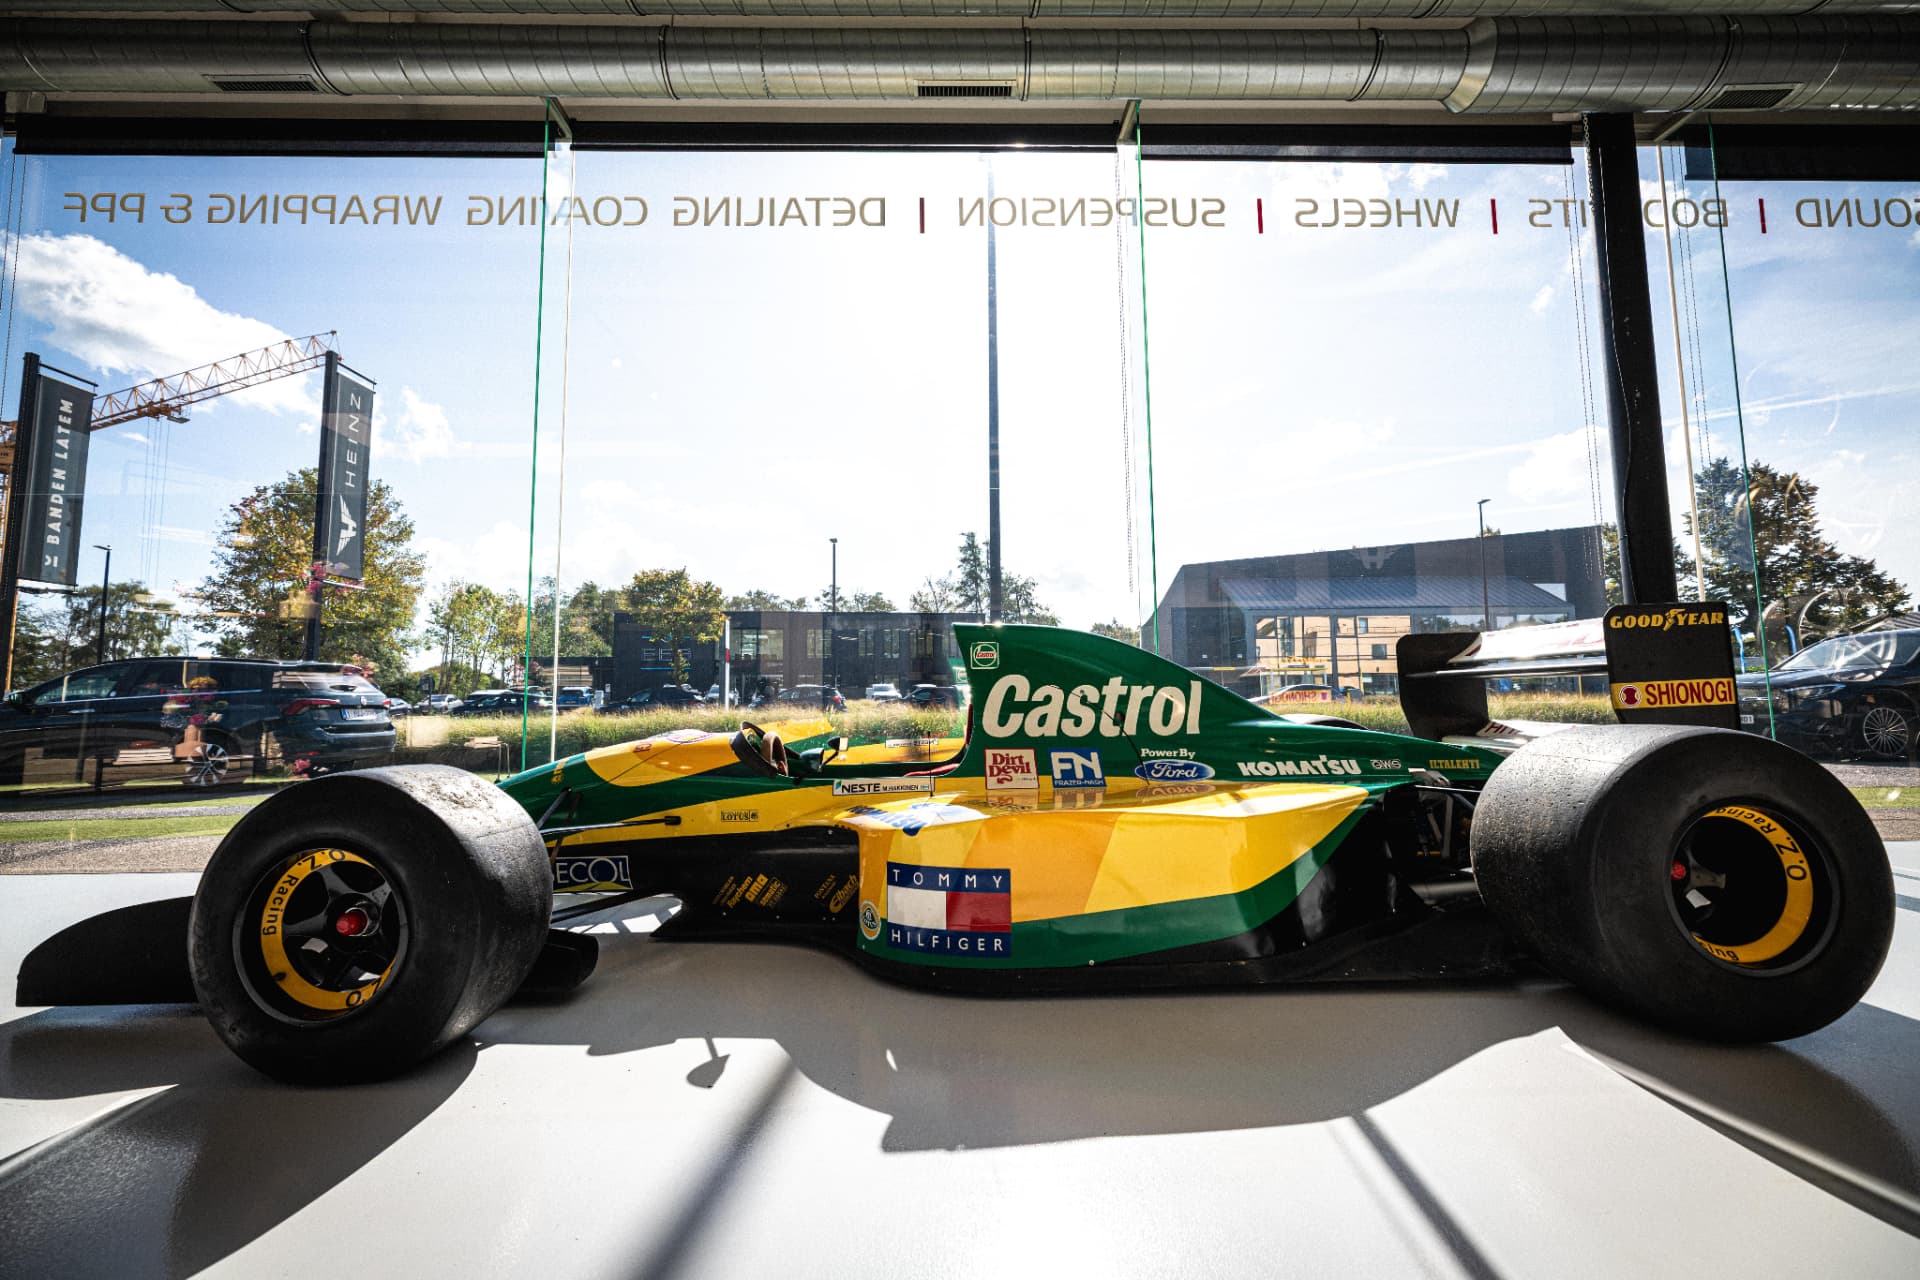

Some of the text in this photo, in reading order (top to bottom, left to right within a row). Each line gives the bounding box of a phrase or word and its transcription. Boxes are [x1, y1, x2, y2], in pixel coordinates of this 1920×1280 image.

[345, 392, 362, 488] HEINZ
[46, 399, 74, 545] BANDEN LATEM
[1645, 680, 1733, 706] SHIONOGI
[981, 674, 1202, 738] Castrol
[991, 753, 1025, 766] Dirt
[1140, 748, 1196, 759] Power By
[988, 762, 1032, 777] Devil
[1150, 763, 1199, 778] Ford
[1236, 755, 1362, 776] KOMATSU
[841, 783, 880, 793] NESTE
[552, 857, 630, 884] ECOL
[892, 869, 1003, 889] TOMMY
[262, 874, 300, 936] Racing
[891, 930, 1003, 952] HILFIGER
